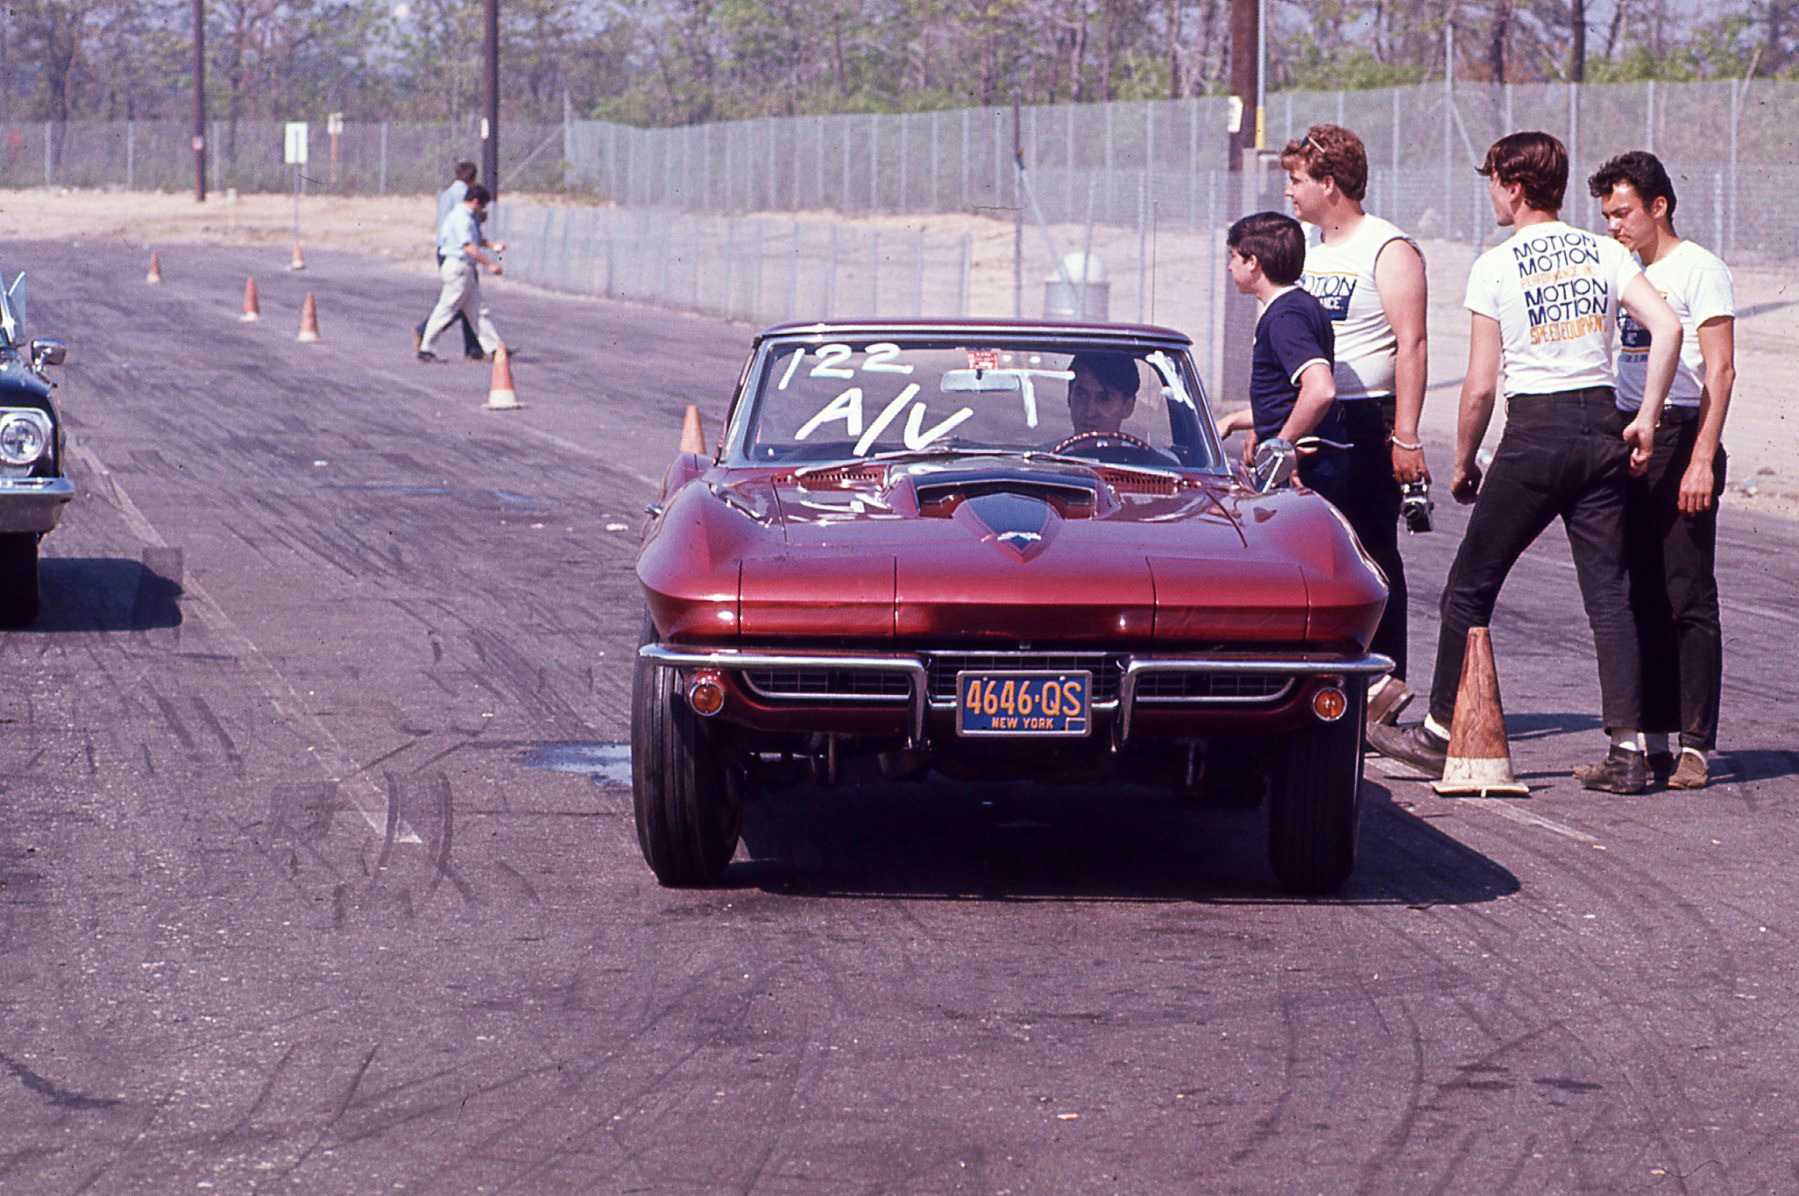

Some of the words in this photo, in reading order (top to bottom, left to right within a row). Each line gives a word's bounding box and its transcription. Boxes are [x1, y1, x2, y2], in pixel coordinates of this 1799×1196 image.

[1512, 232, 1597, 261] MOTION
[1518, 247, 1600, 279] MOTION
[1301, 274, 1357, 297] OTION
[1524, 278, 1608, 308] MOTION
[1528, 296, 1608, 328] MOTION
[778, 342, 914, 390] 122
[991, 717, 1019, 729] NEW
[1023, 717, 1054, 729] YORK
